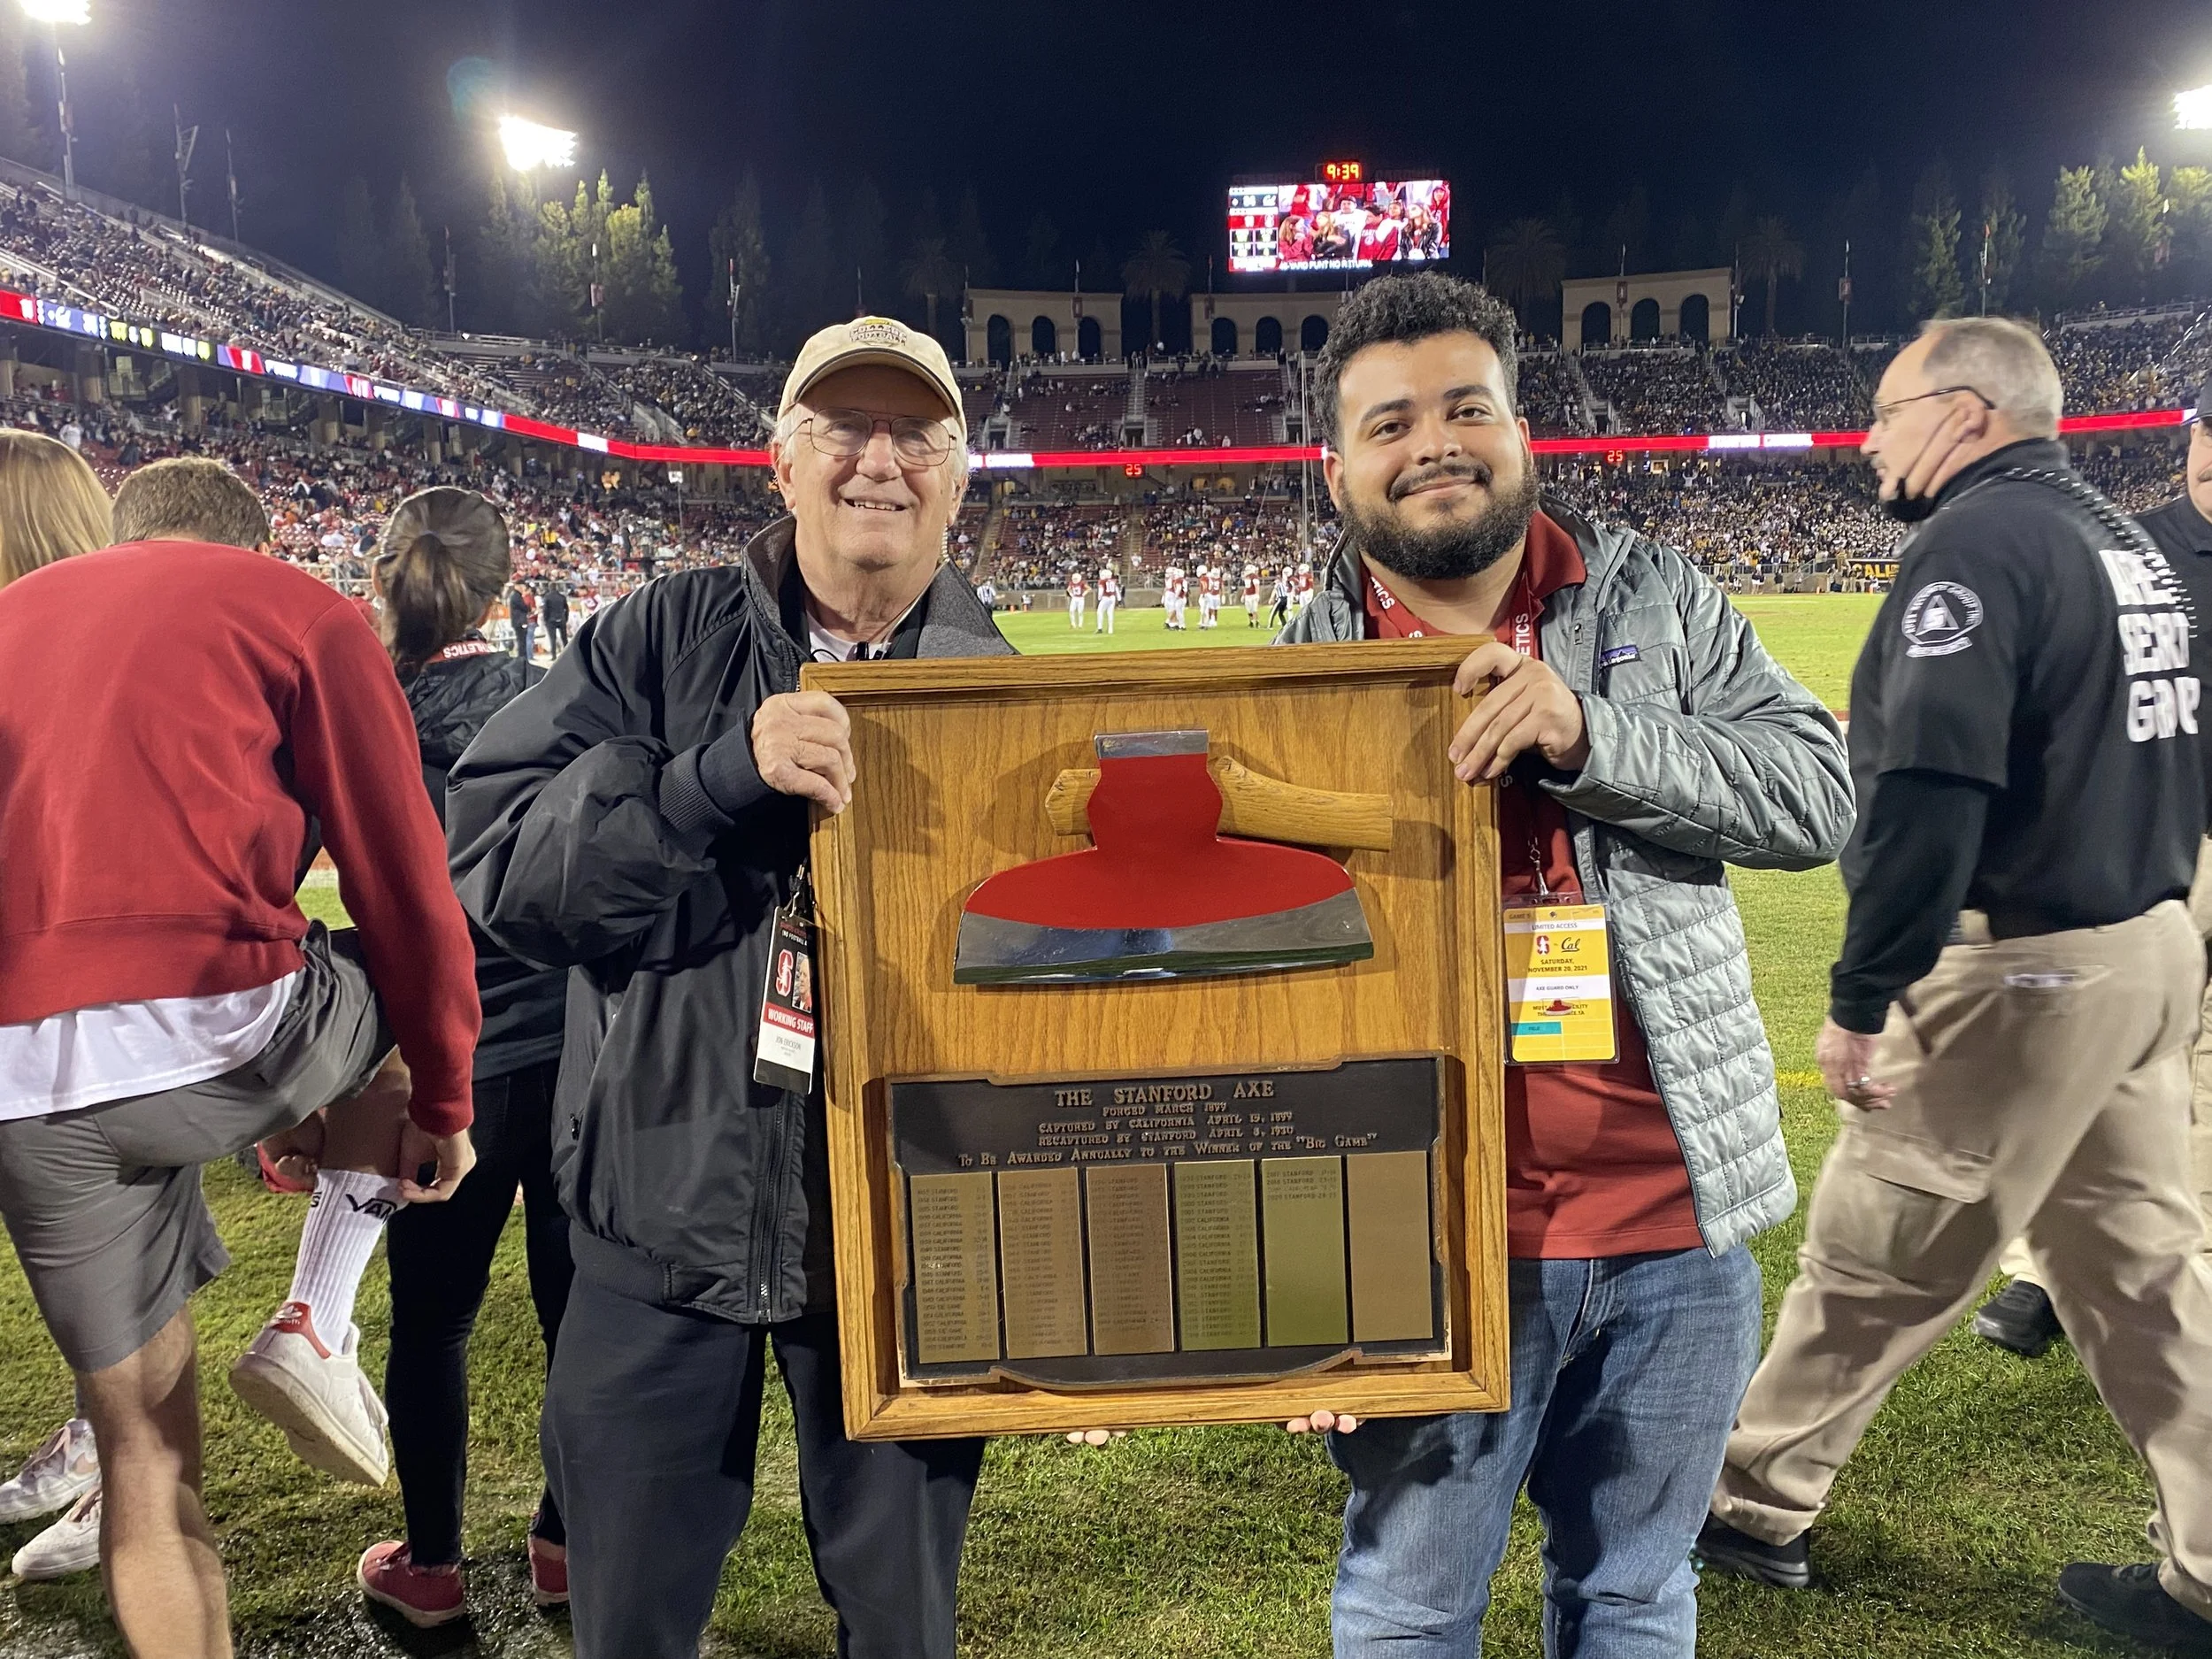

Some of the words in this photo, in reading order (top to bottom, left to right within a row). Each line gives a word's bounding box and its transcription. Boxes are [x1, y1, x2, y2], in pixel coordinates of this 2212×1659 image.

[1327, 164, 1359, 180] 9:39
[1609, 449, 1623, 462] 25
[1125, 464, 1141, 475] 25
[1561, 937, 1581, 953] Cal
[768, 1008, 797, 1029] WORKING
[797, 1018, 814, 1034] STAFF
[1055, 1089, 1093, 1107] THE
[1113, 1084, 1212, 1105] STANFORD
[1233, 1079, 1274, 1099] AXE
[1102, 1105, 1146, 1117] FORGED
[1155, 1103, 1194, 1115] MARCH
[1204, 1102, 1227, 1112] 1899
[1038, 1122, 1095, 1134] CAPTURED
[1105, 1120, 1119, 1131] BY
[1128, 1117, 1194, 1129] CALIFORNIA
[1207, 1114, 1242, 1125] APRIL
[1270, 1112, 1292, 1123] 1899
[1038, 1134, 1109, 1148] RECAPTURED
[1117, 1133, 1131, 1143] BY
[1141, 1130, 1196, 1142] STANFORD
[1209, 1128, 1243, 1139] APRIL
[1271, 1125, 1294, 1136] 1930
[1140, 1147, 1155, 1157] TO
[1163, 1145, 1186, 1156] THE
[1249, 1142, 1263, 1153] OF
[1271, 1141, 1292, 1151] THE
